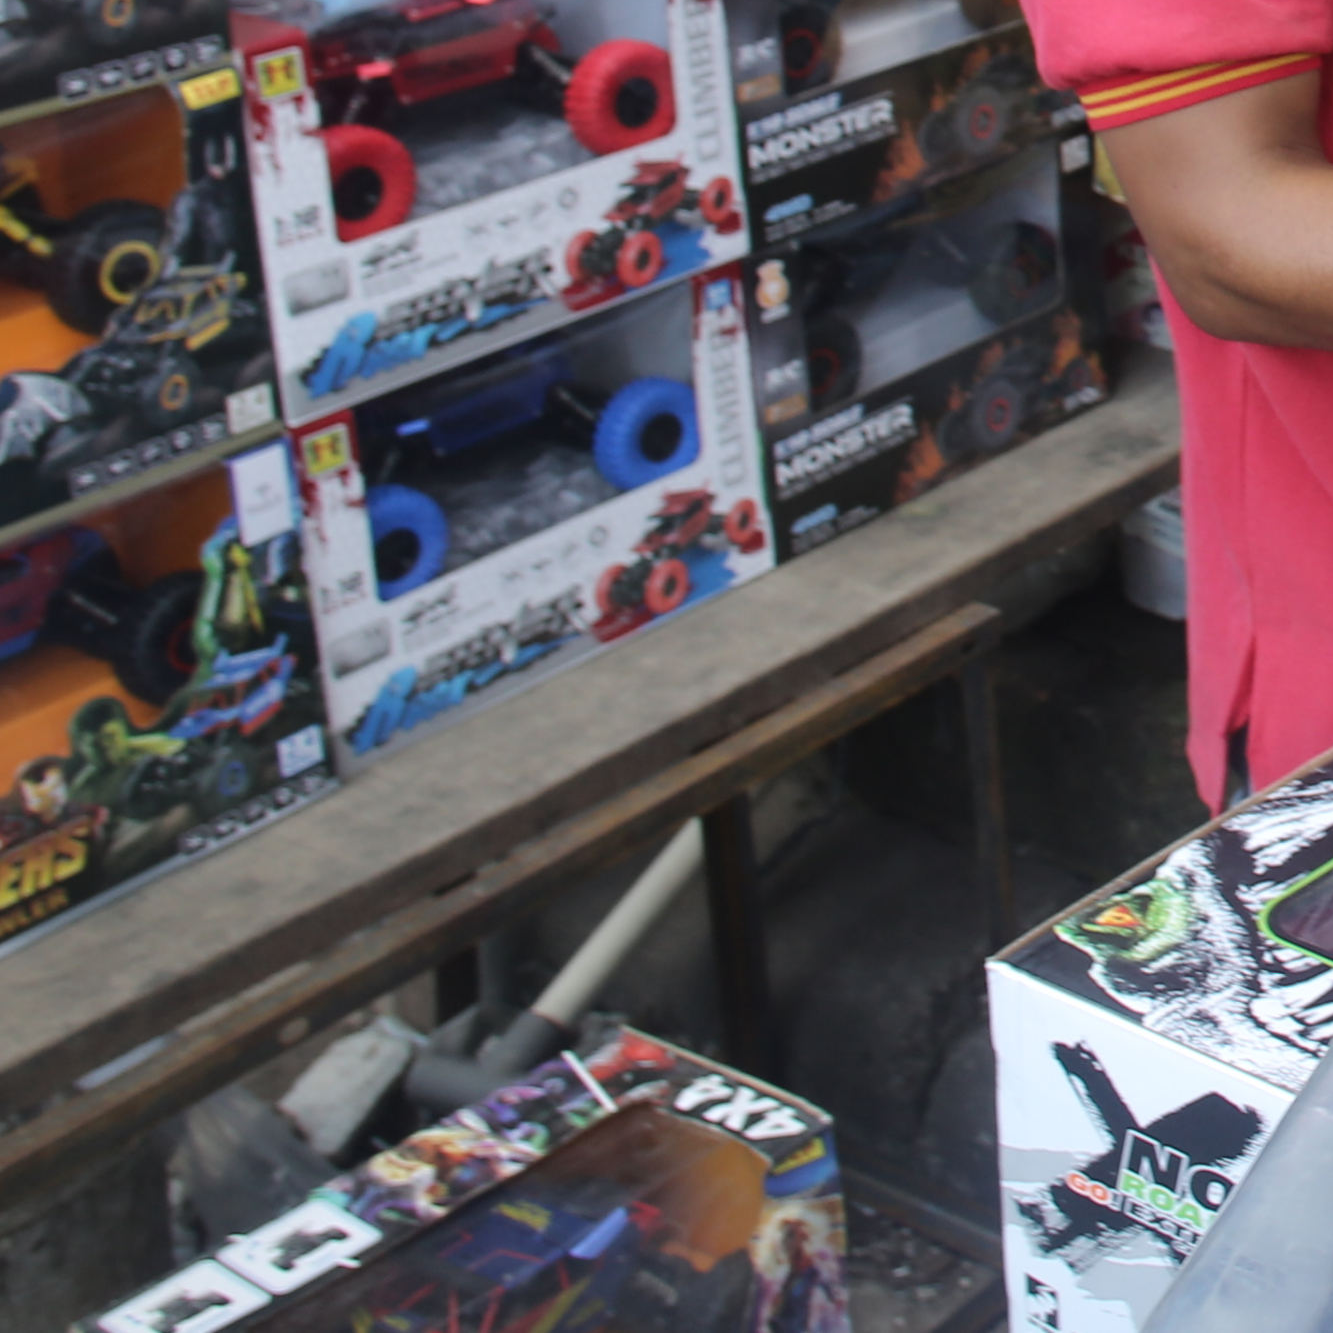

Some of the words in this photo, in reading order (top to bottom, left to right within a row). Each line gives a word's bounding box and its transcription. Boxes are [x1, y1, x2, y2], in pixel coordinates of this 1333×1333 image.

[748, 96, 896, 170] MONSTER
[773, 403, 916, 487] MONSTER
[673, 1072, 807, 1143] 4X4
[1118, 1168, 1219, 1229] ROA
